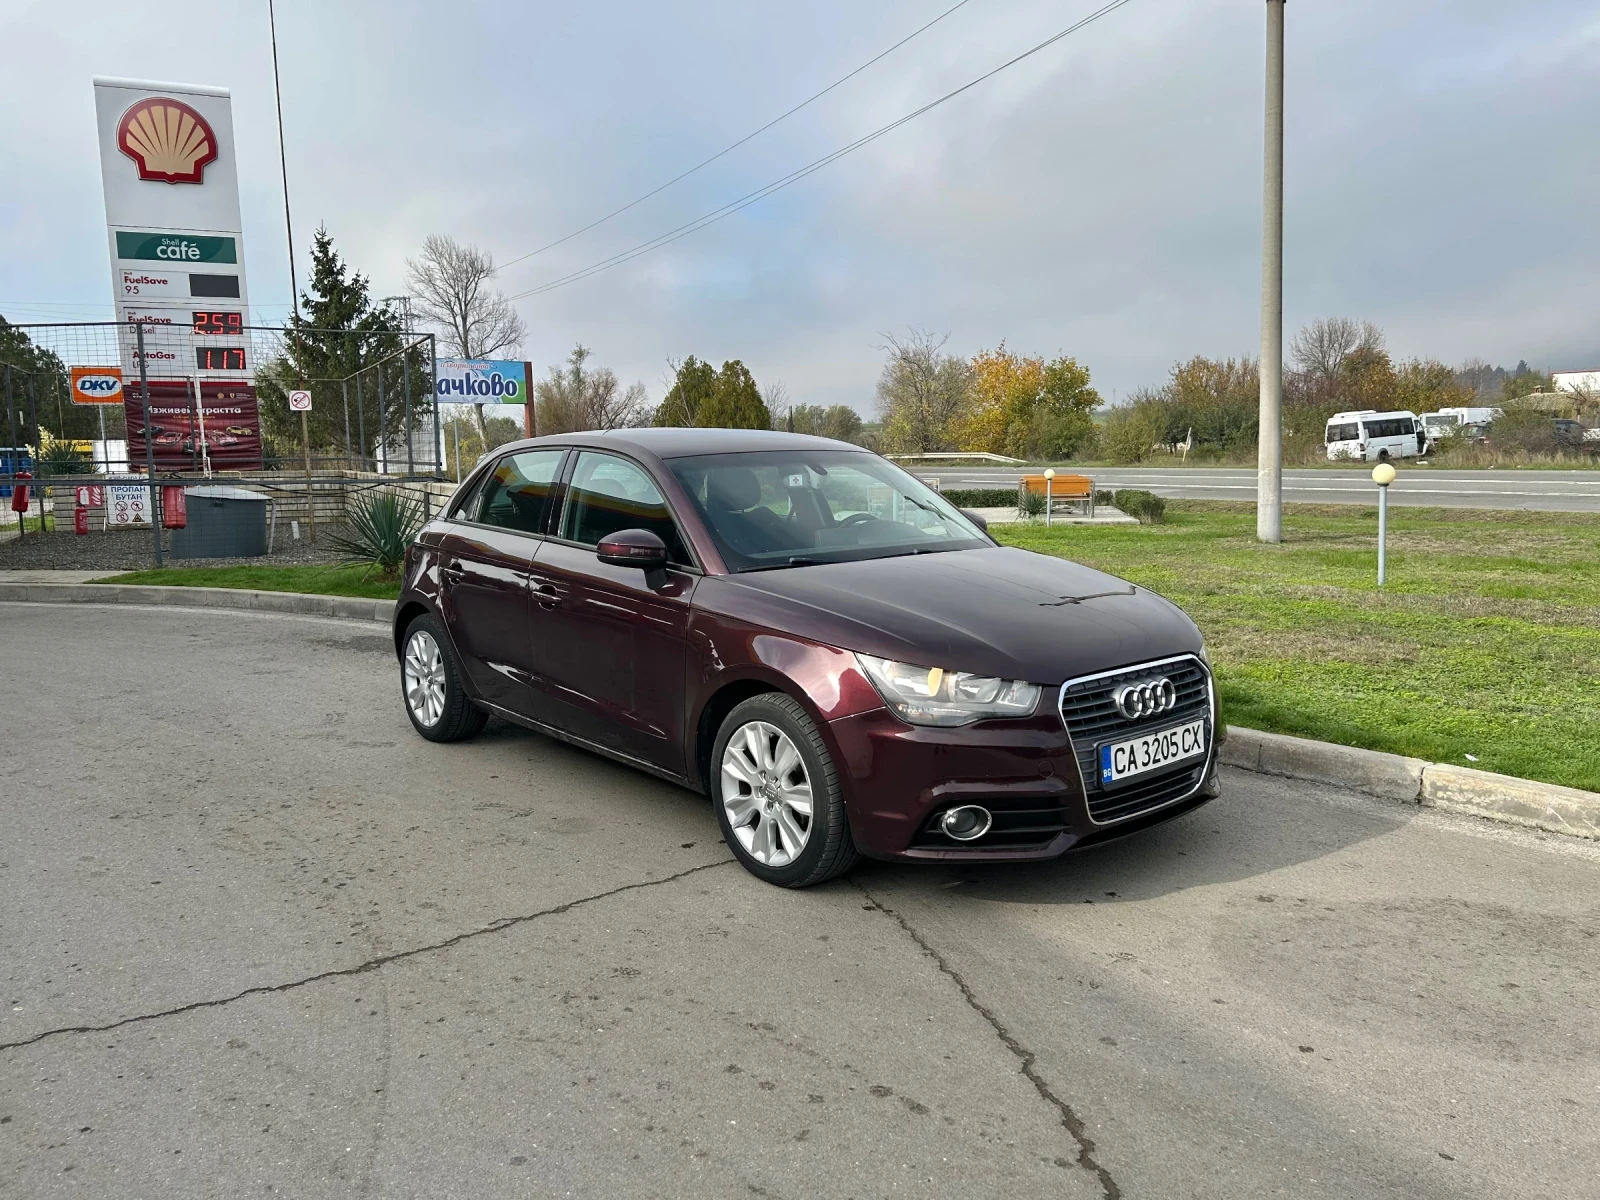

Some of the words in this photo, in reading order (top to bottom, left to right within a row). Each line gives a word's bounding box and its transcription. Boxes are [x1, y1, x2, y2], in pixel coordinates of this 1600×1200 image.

[161, 238, 180, 246] Shell
[156, 241, 201, 260] café
[123, 275, 168, 285] FuelSave
[125, 285, 140, 295] 95
[127, 315, 172, 324] FuelSave
[129, 325, 155, 334] Dsel
[206, 350, 243, 370] 1.17
[80, 380, 118, 390] DKV
[437, 372, 518, 397] ачково
[196, 407, 242, 416] трастта
[1114, 744, 1138, 775] CA
[1141, 731, 1179, 767] 3205
[1181, 724, 1201, 754] CX
[1103, 768, 1112, 778] BG
